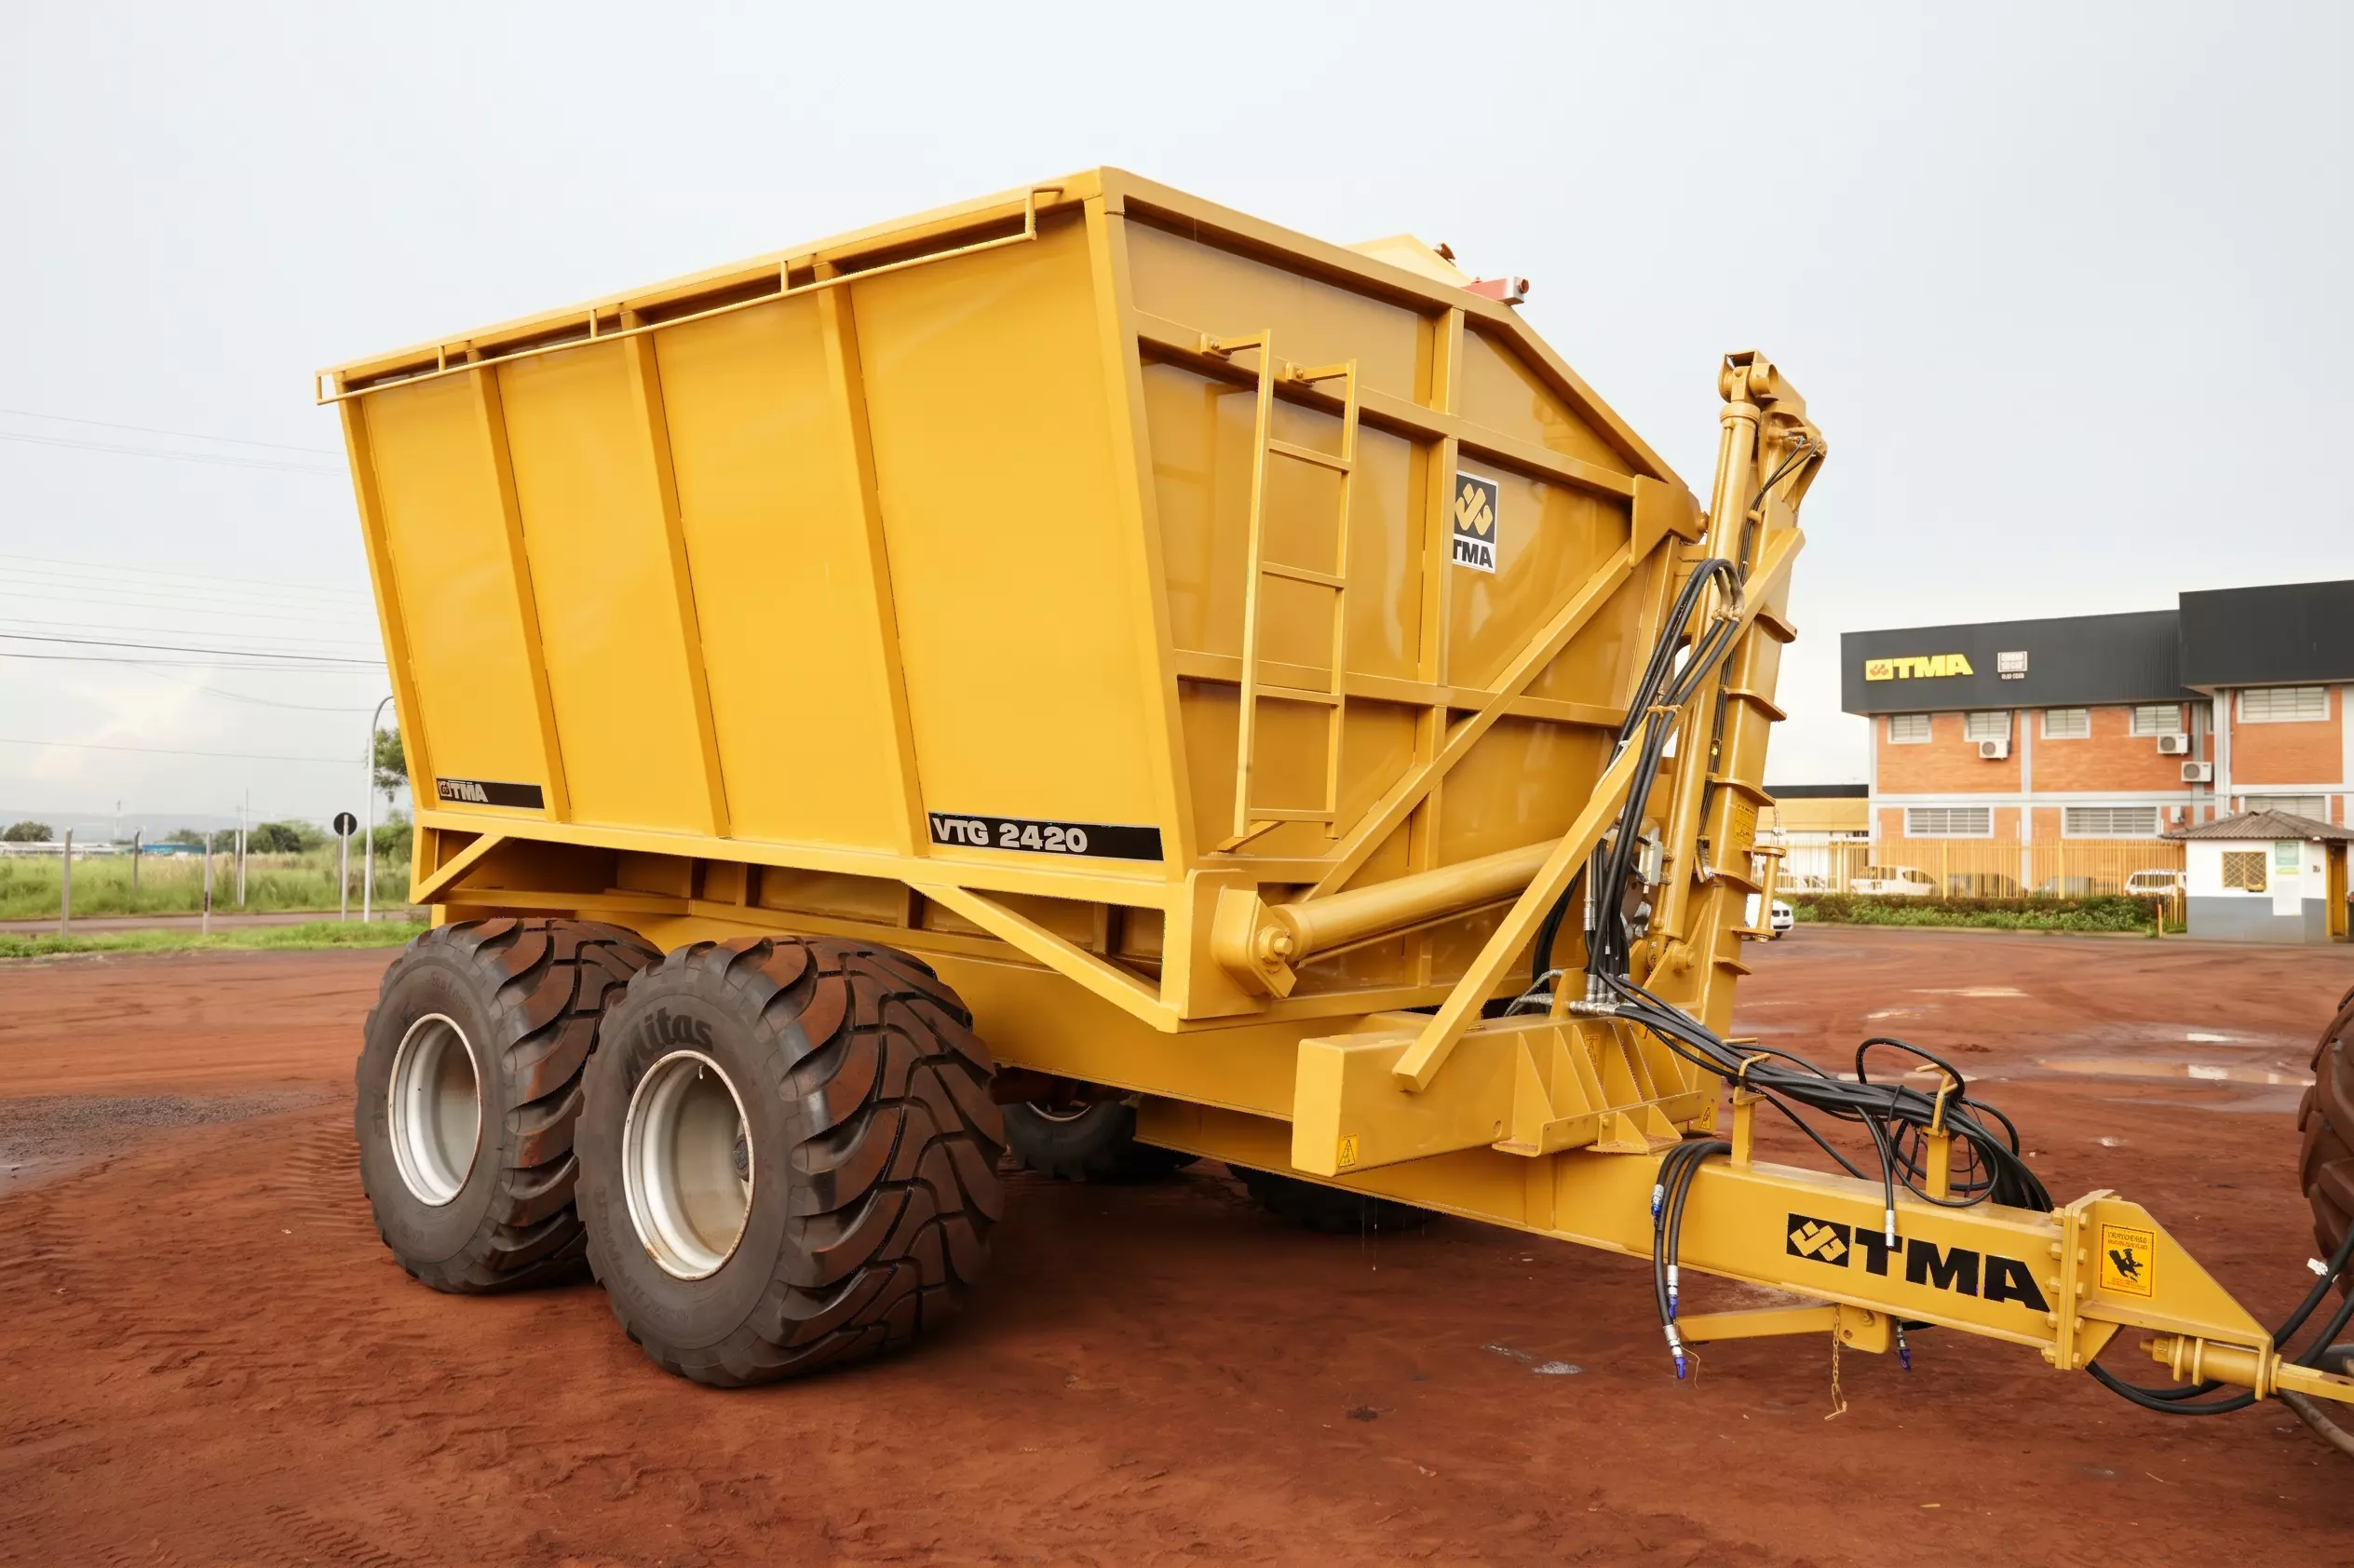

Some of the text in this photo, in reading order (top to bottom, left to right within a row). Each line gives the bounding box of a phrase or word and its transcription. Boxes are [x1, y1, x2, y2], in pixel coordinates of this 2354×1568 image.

[1893, 654, 1974, 679] TMA
[451, 782, 489, 803] TMA
[932, 818, 1088, 853] VTG 2420
[1854, 1226, 2050, 1313] TMA
